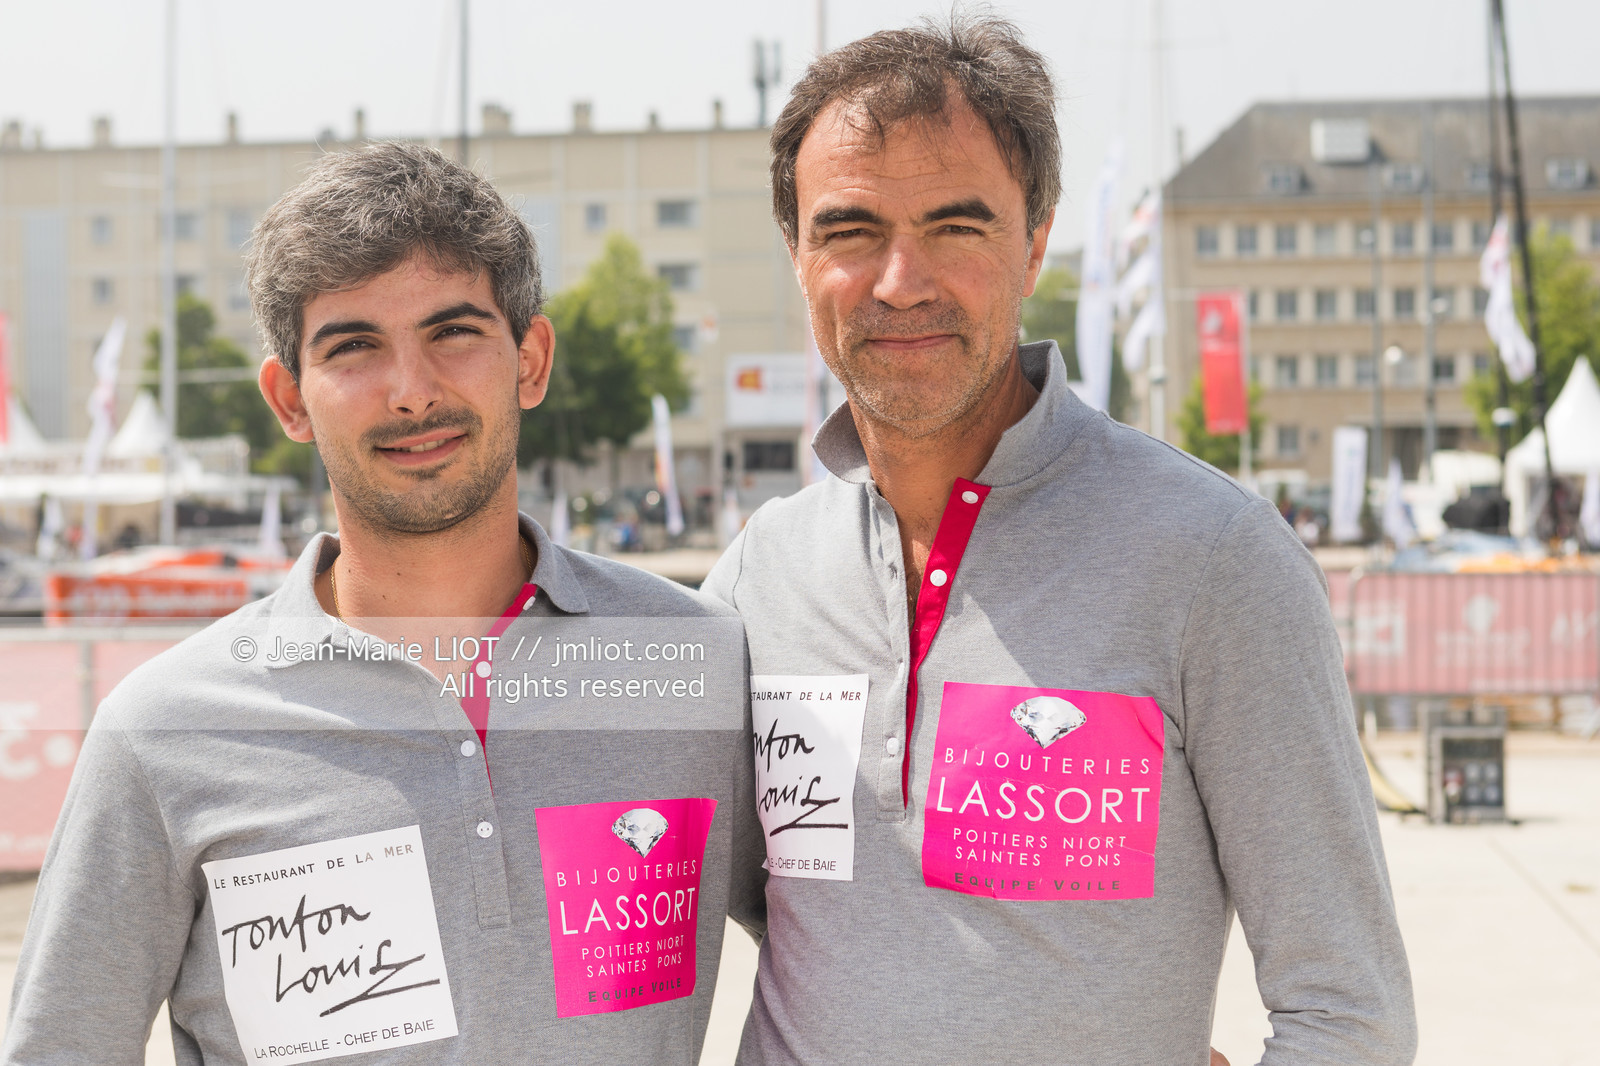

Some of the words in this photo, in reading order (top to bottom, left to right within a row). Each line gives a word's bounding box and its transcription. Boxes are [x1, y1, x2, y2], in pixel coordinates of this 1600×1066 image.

[799, 691, 813, 701] DE
[820, 691, 833, 701] LA
[840, 690, 861, 701] MER
[945, 747, 1150, 775] BIJOUTERIES
[936, 777, 1150, 824] LASSORT
[953, 828, 1048, 849] POITIERS
[1063, 836, 1127, 851] NIORT
[213, 878, 227, 890] LE
[233, 863, 316, 887] RESTAURANT
[326, 857, 345, 870] DE
[355, 851, 374, 864] LA
[384, 844, 414, 858] MER
[778, 856, 796, 870] CHEF
[797, 859, 811, 870] DE
[813, 858, 837, 871] BAIE
[955, 846, 1041, 867] SAINTES
[1065, 853, 1121, 868] PONS
[556, 859, 697, 887] BIJOUTERIES
[954, 872, 1037, 891] EQUIPE
[1053, 879, 1121, 892] VOILE
[559, 887, 696, 936] LASSORT
[221, 894, 371, 968] Tonton
[581, 941, 650, 961] POITIERS
[656, 934, 684, 951] NIORT
[276, 939, 440, 1017] Louis
[586, 959, 647, 978] SAINTES
[657, 952, 682, 968] PONS
[588, 985, 644, 1003] EQUIPE
[651, 977, 681, 994] VOILE
[254, 1047, 268, 1059] LA
[268, 1038, 330, 1058] ROCHELLE
[343, 1029, 379, 1047] CHEF
[381, 1026, 400, 1040] DE
[403, 1018, 436, 1036] BAIE
